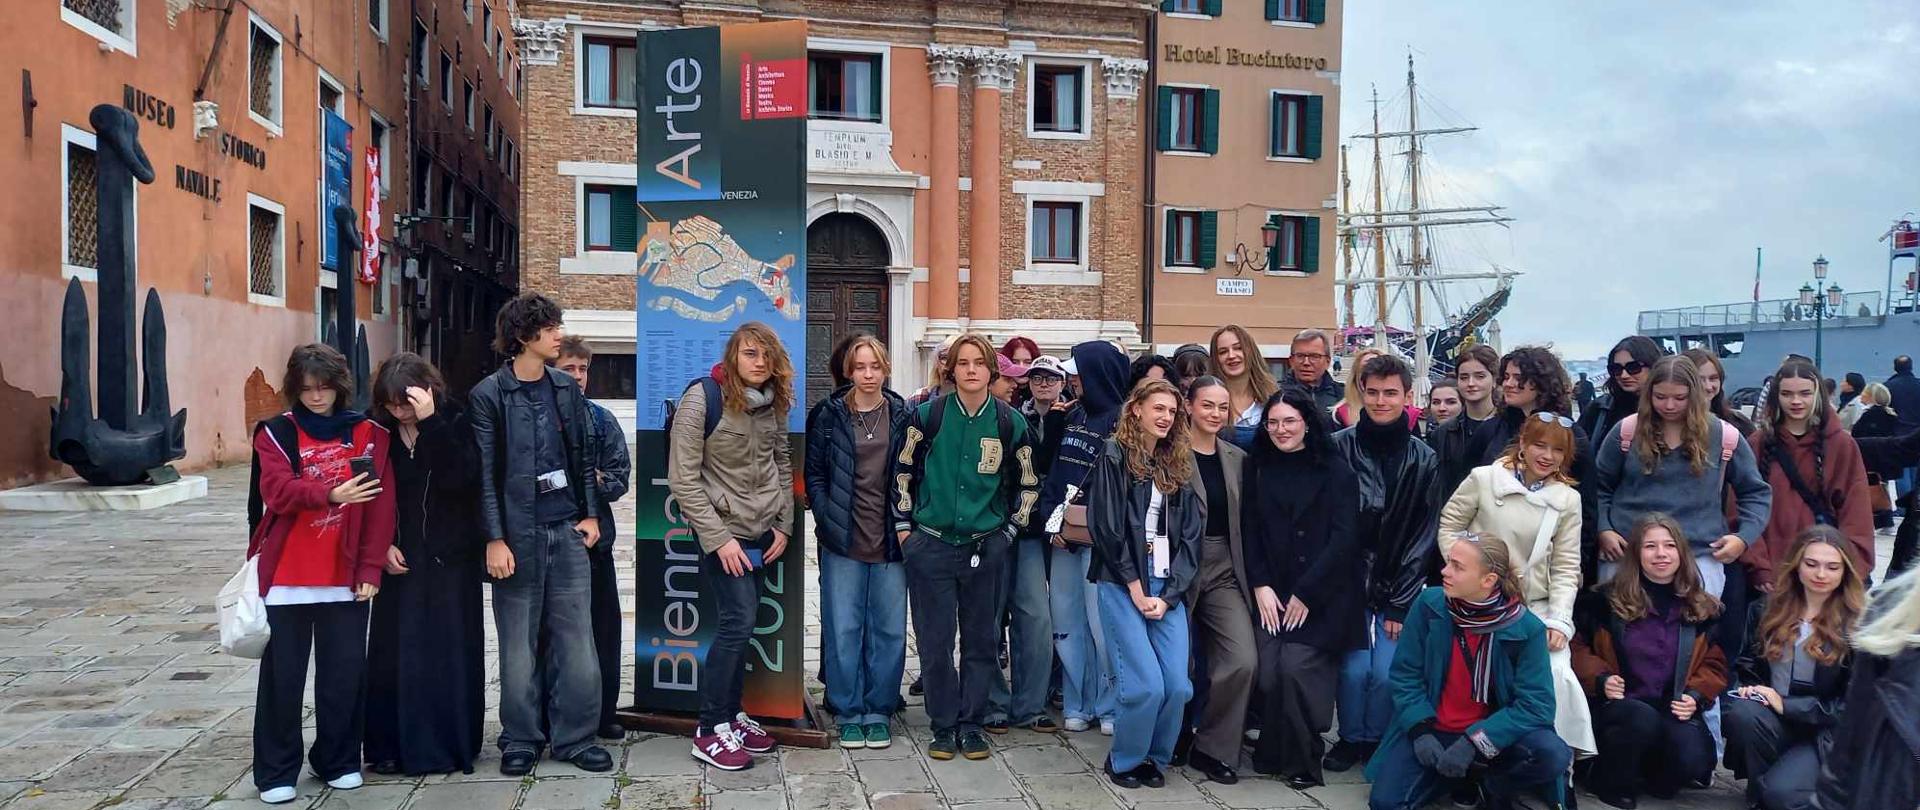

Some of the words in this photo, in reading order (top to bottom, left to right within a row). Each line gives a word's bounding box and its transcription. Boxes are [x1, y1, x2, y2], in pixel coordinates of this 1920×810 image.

[1164, 44, 1220, 65] Hotel
[1226, 48, 1328, 71] Bucintoro
[123, 84, 175, 130] MUSEO
[656, 58, 702, 190] Arte
[221, 132, 266, 170] STORICO
[176, 165, 222, 203] NAVALE
[721, 191, 758, 200] VENEZIA
